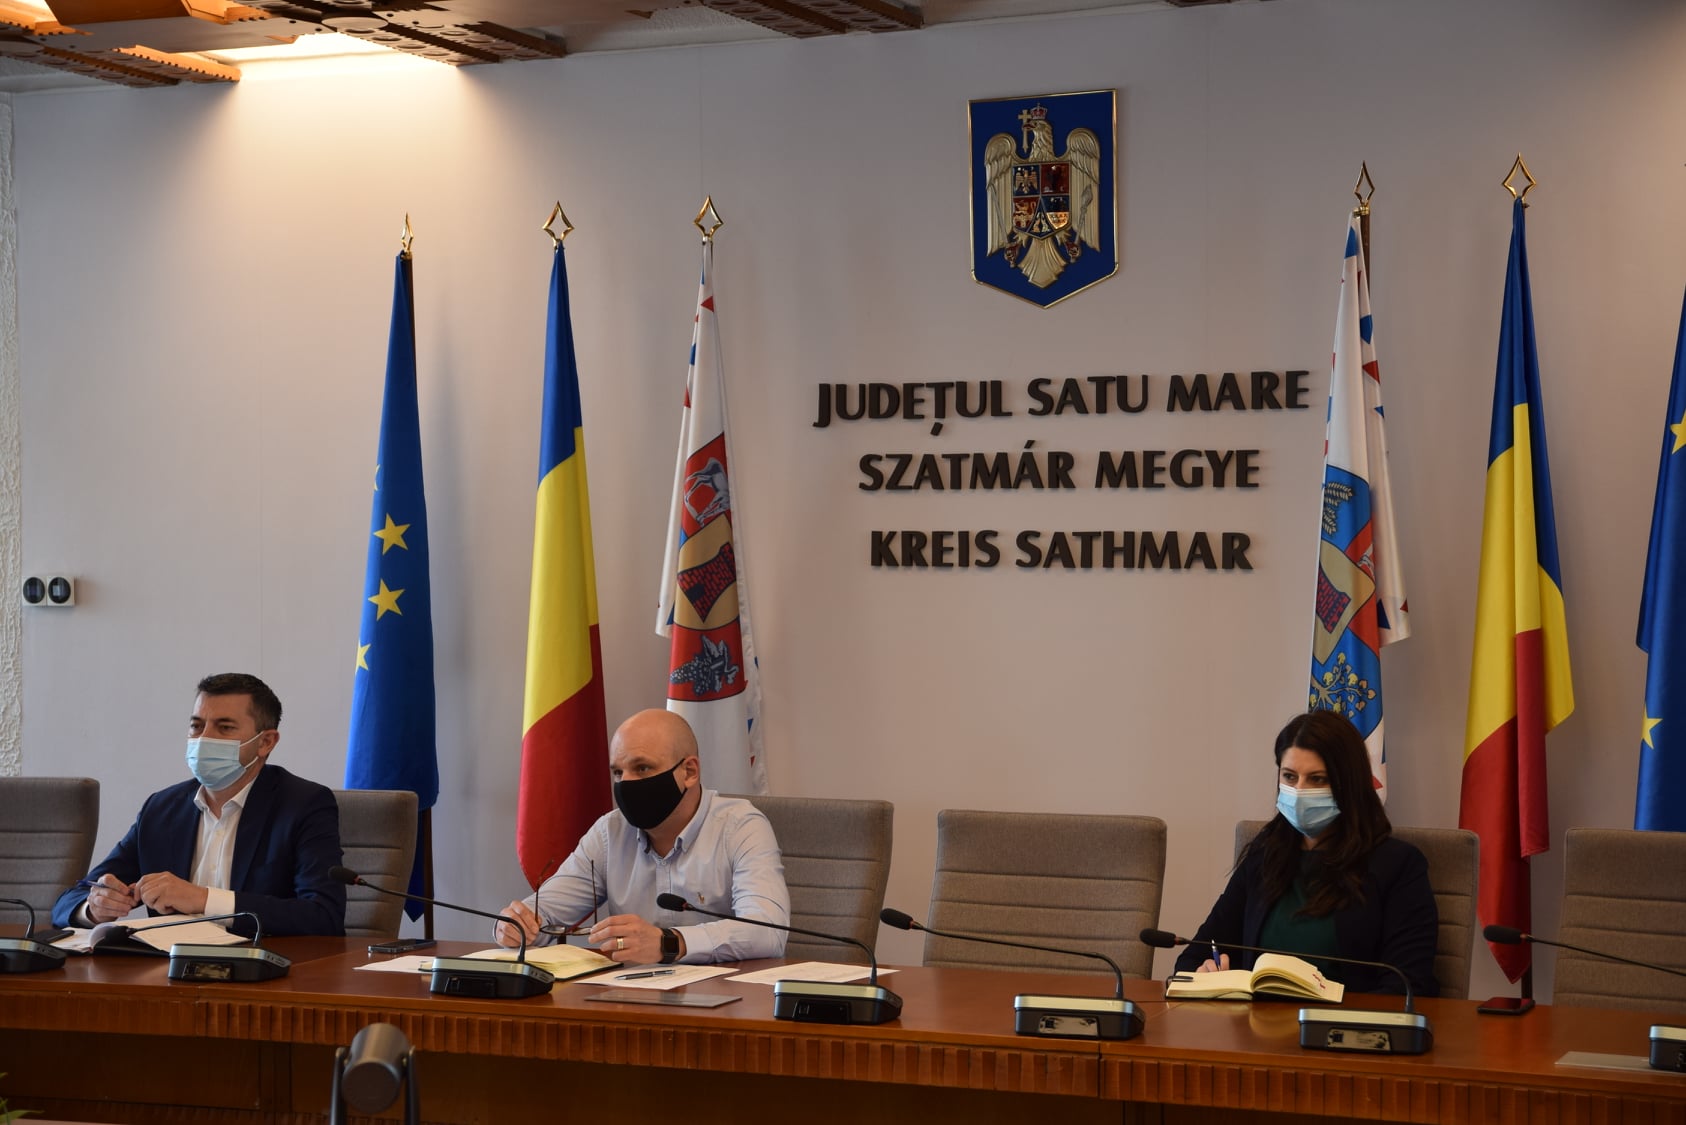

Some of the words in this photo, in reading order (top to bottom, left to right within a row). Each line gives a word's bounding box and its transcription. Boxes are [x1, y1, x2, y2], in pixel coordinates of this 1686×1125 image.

[813, 380, 1013, 437] JUDEȚUL
[1028, 375, 1149, 416] SATU
[1167, 370, 1310, 412] MARE
[859, 440, 1077, 491] SZATMÁR
[1095, 449, 1261, 489] MEGYE
[871, 530, 1001, 568] KREIS
[1016, 530, 1254, 570] SATHMAR
